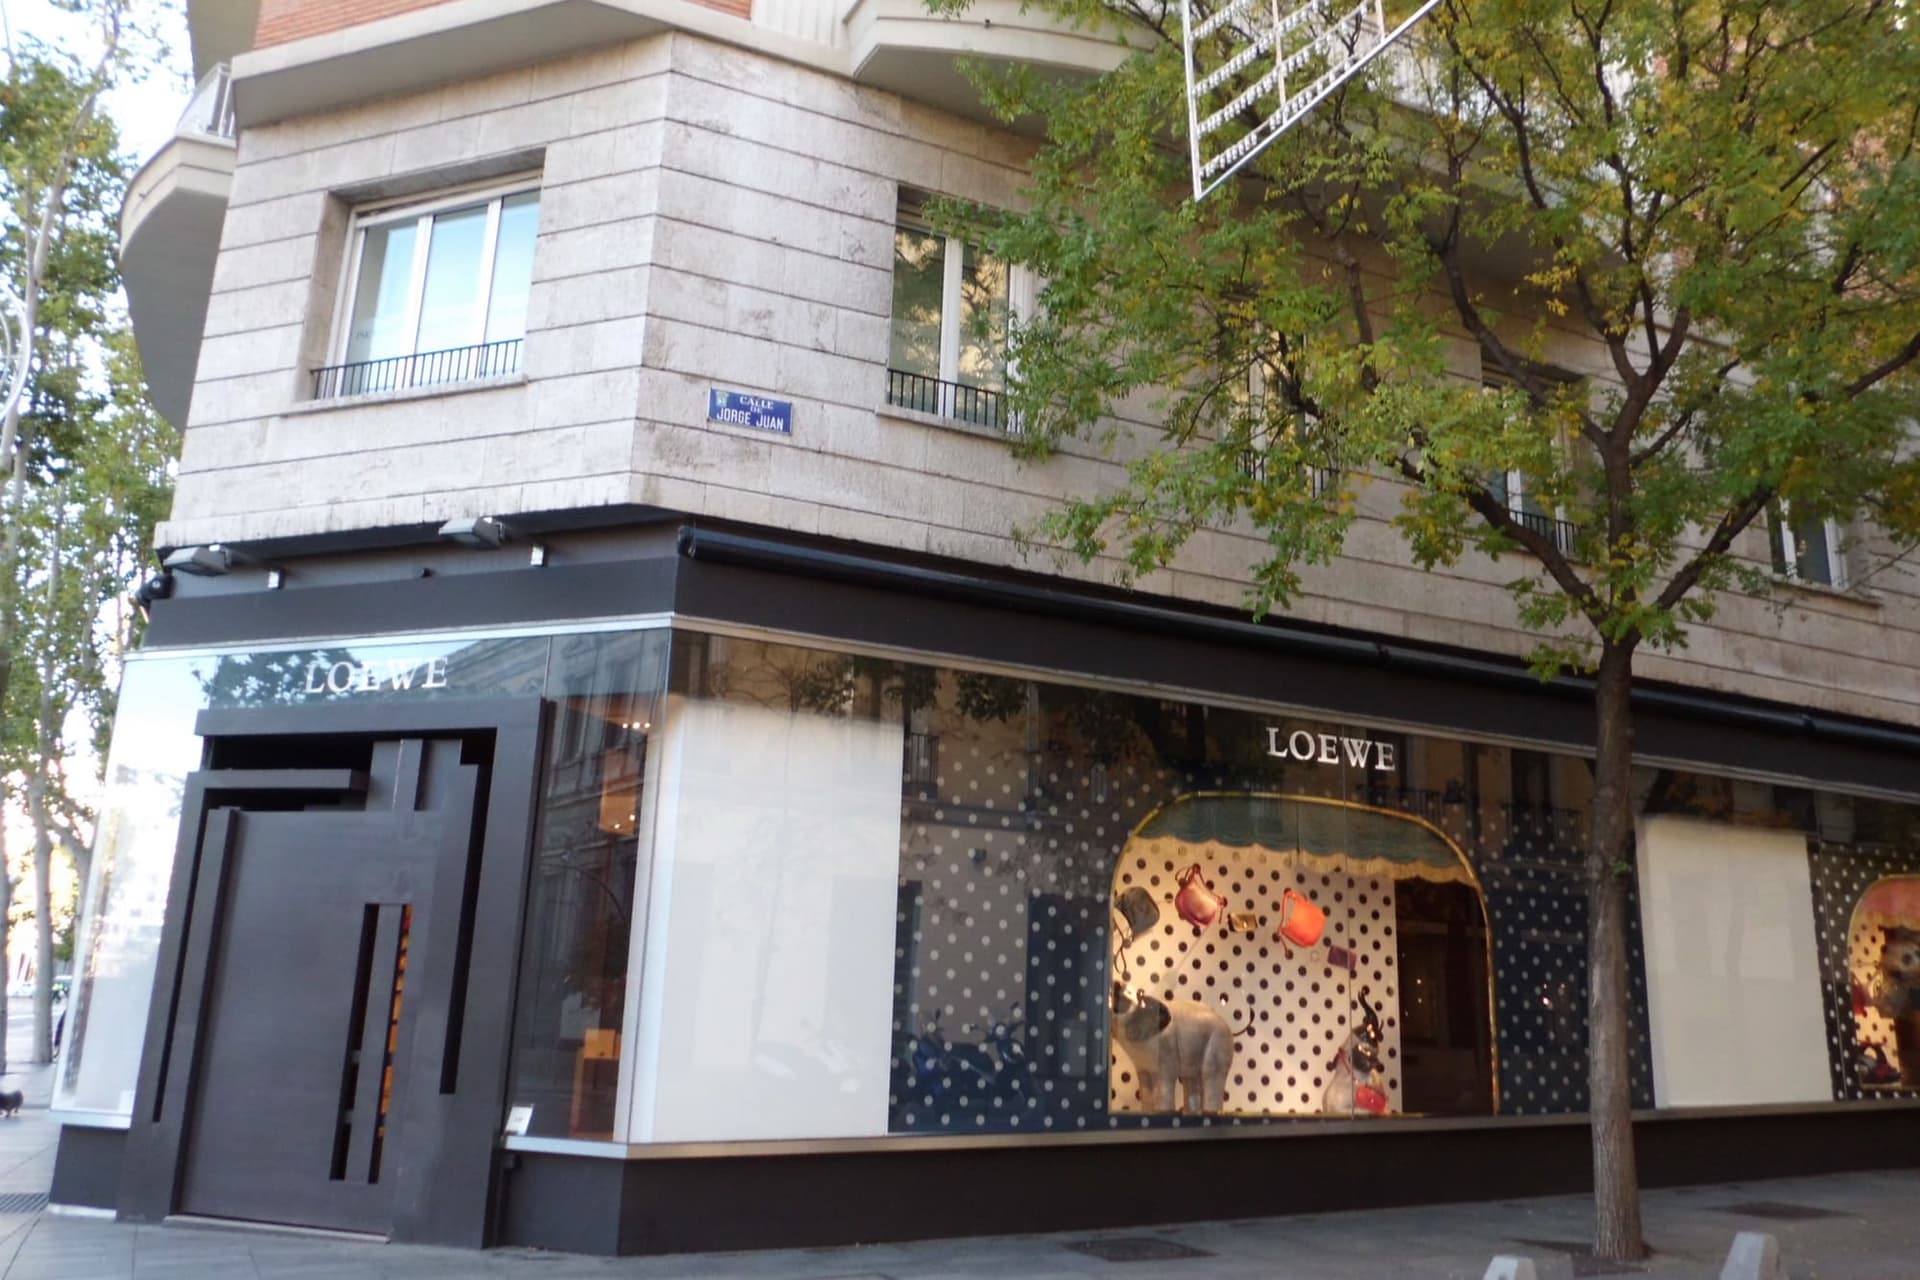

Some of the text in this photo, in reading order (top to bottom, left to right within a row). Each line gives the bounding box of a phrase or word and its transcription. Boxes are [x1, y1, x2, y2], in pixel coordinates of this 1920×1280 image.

[739, 395, 774, 410] CALLE
[716, 407, 784, 431] JORGE JUAN
[304, 656, 449, 694] LOEWE
[1266, 726, 1396, 771] LOEWE
